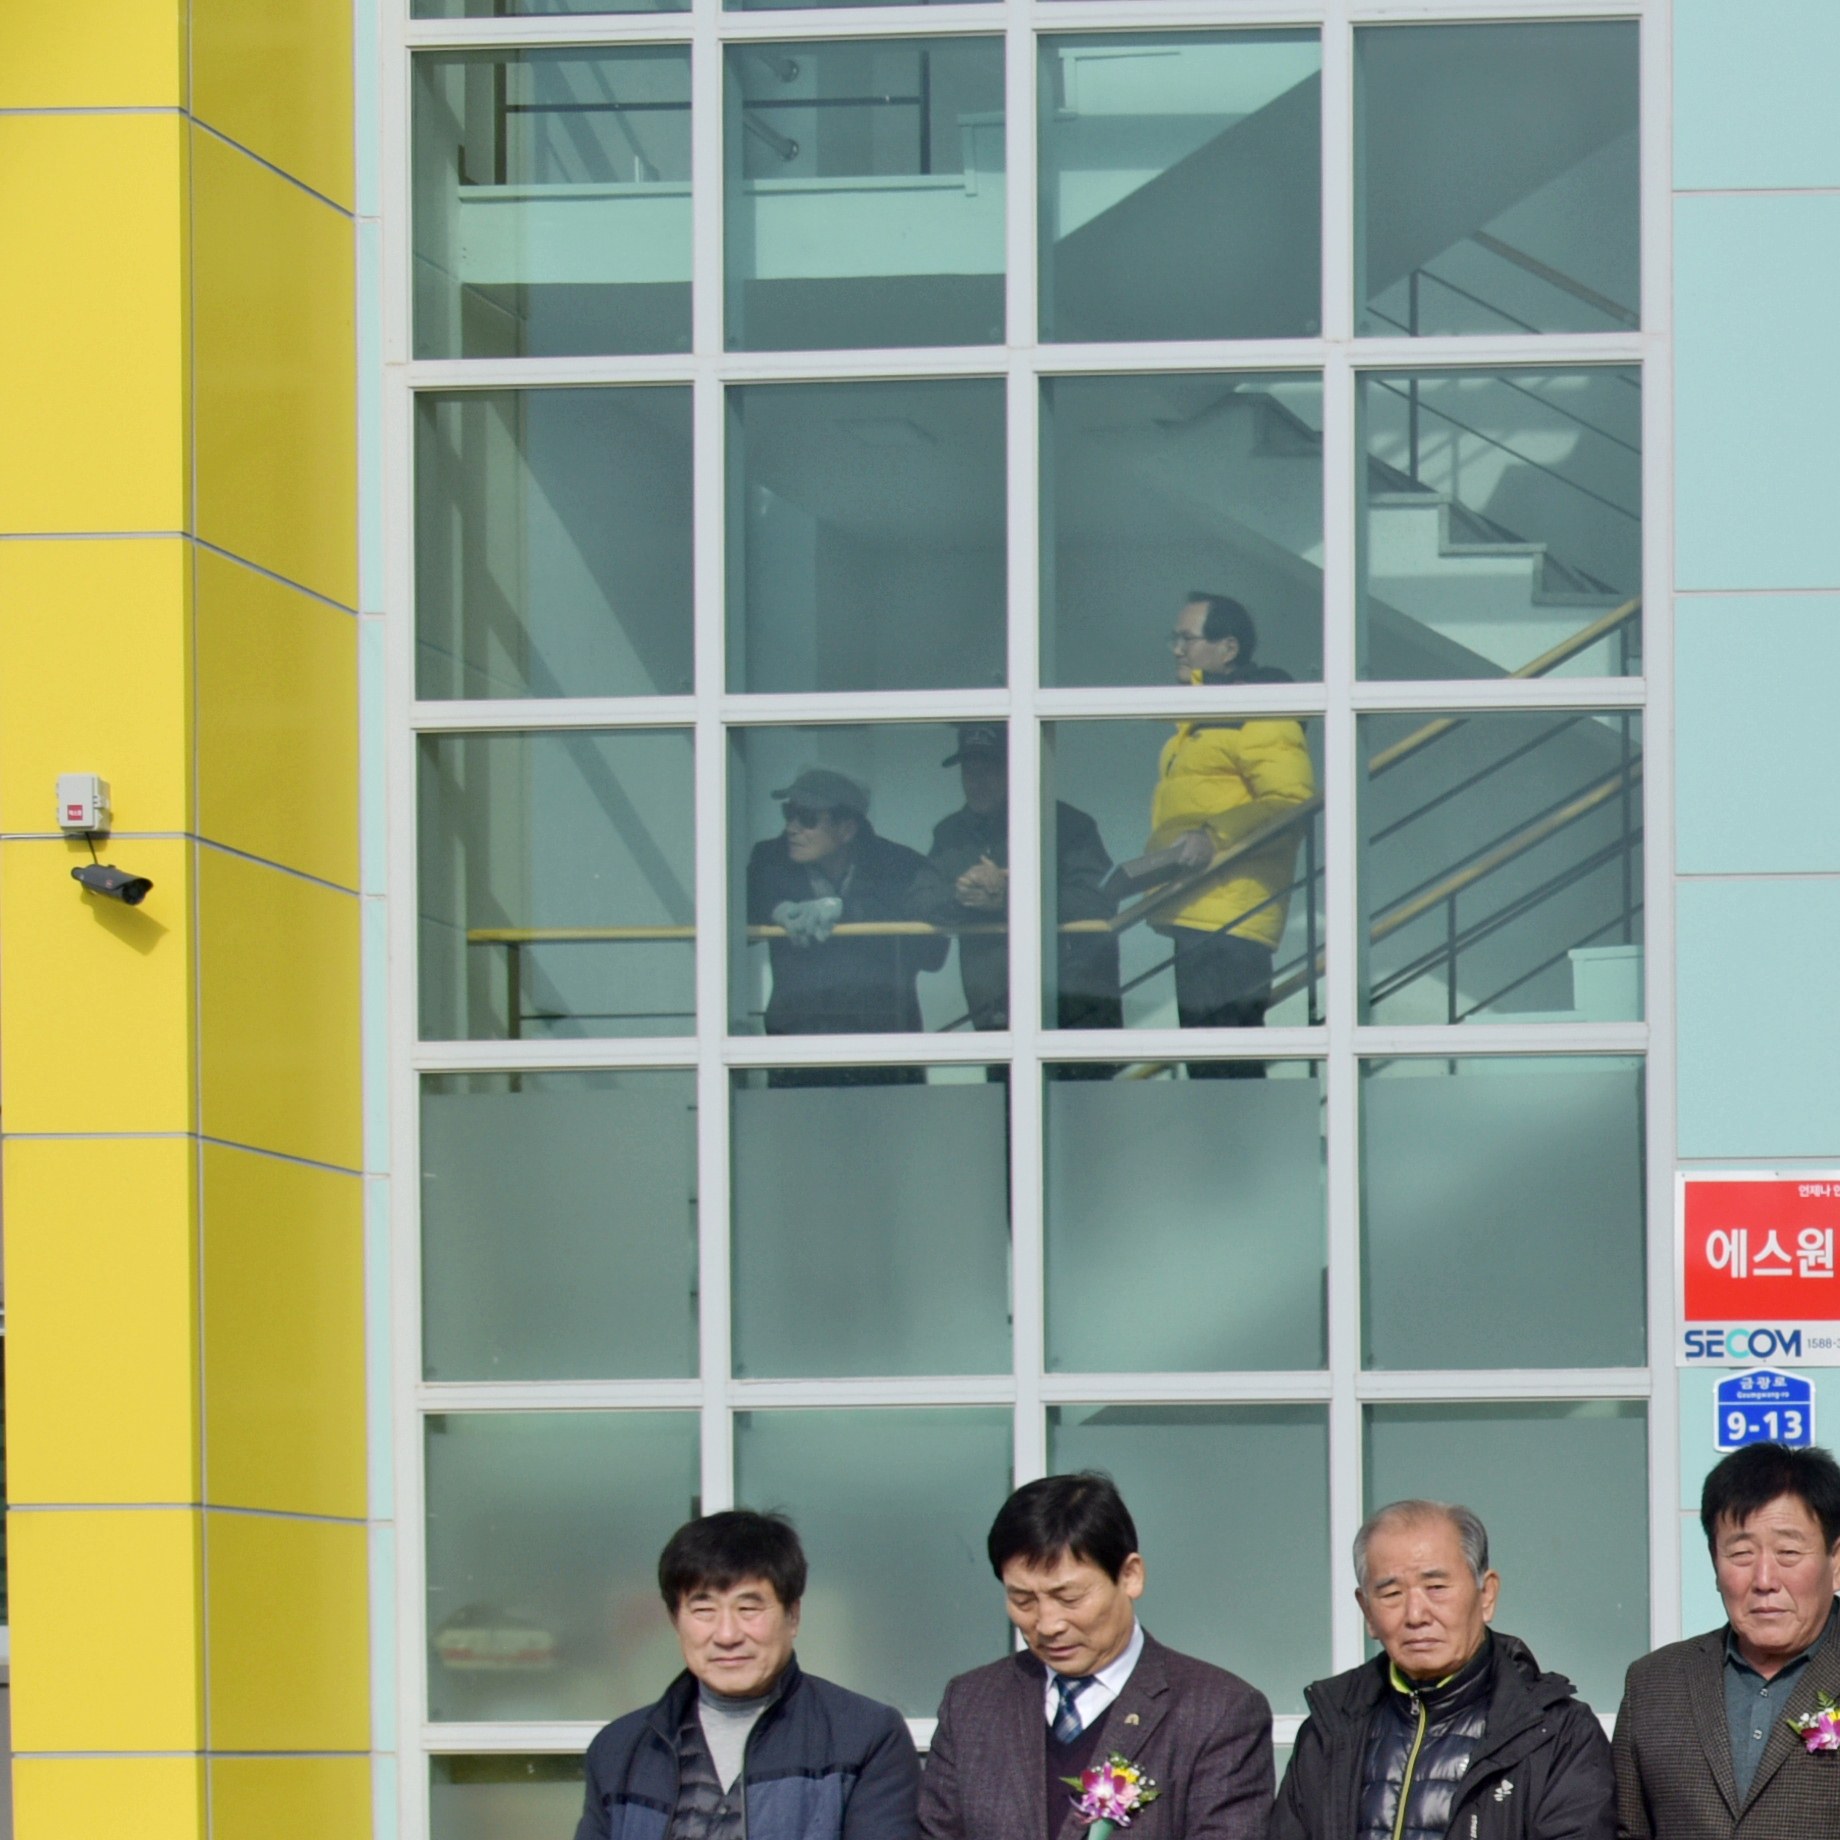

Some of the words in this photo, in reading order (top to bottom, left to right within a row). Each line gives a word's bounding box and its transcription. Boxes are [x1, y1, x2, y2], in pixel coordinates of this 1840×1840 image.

[1798, 1183, 1831, 1198] 언제나
[1705, 1227, 1834, 1279] 에스원
[1684, 1327, 1802, 1359] SECOM
[1726, 1410, 1803, 1441] 9-13
